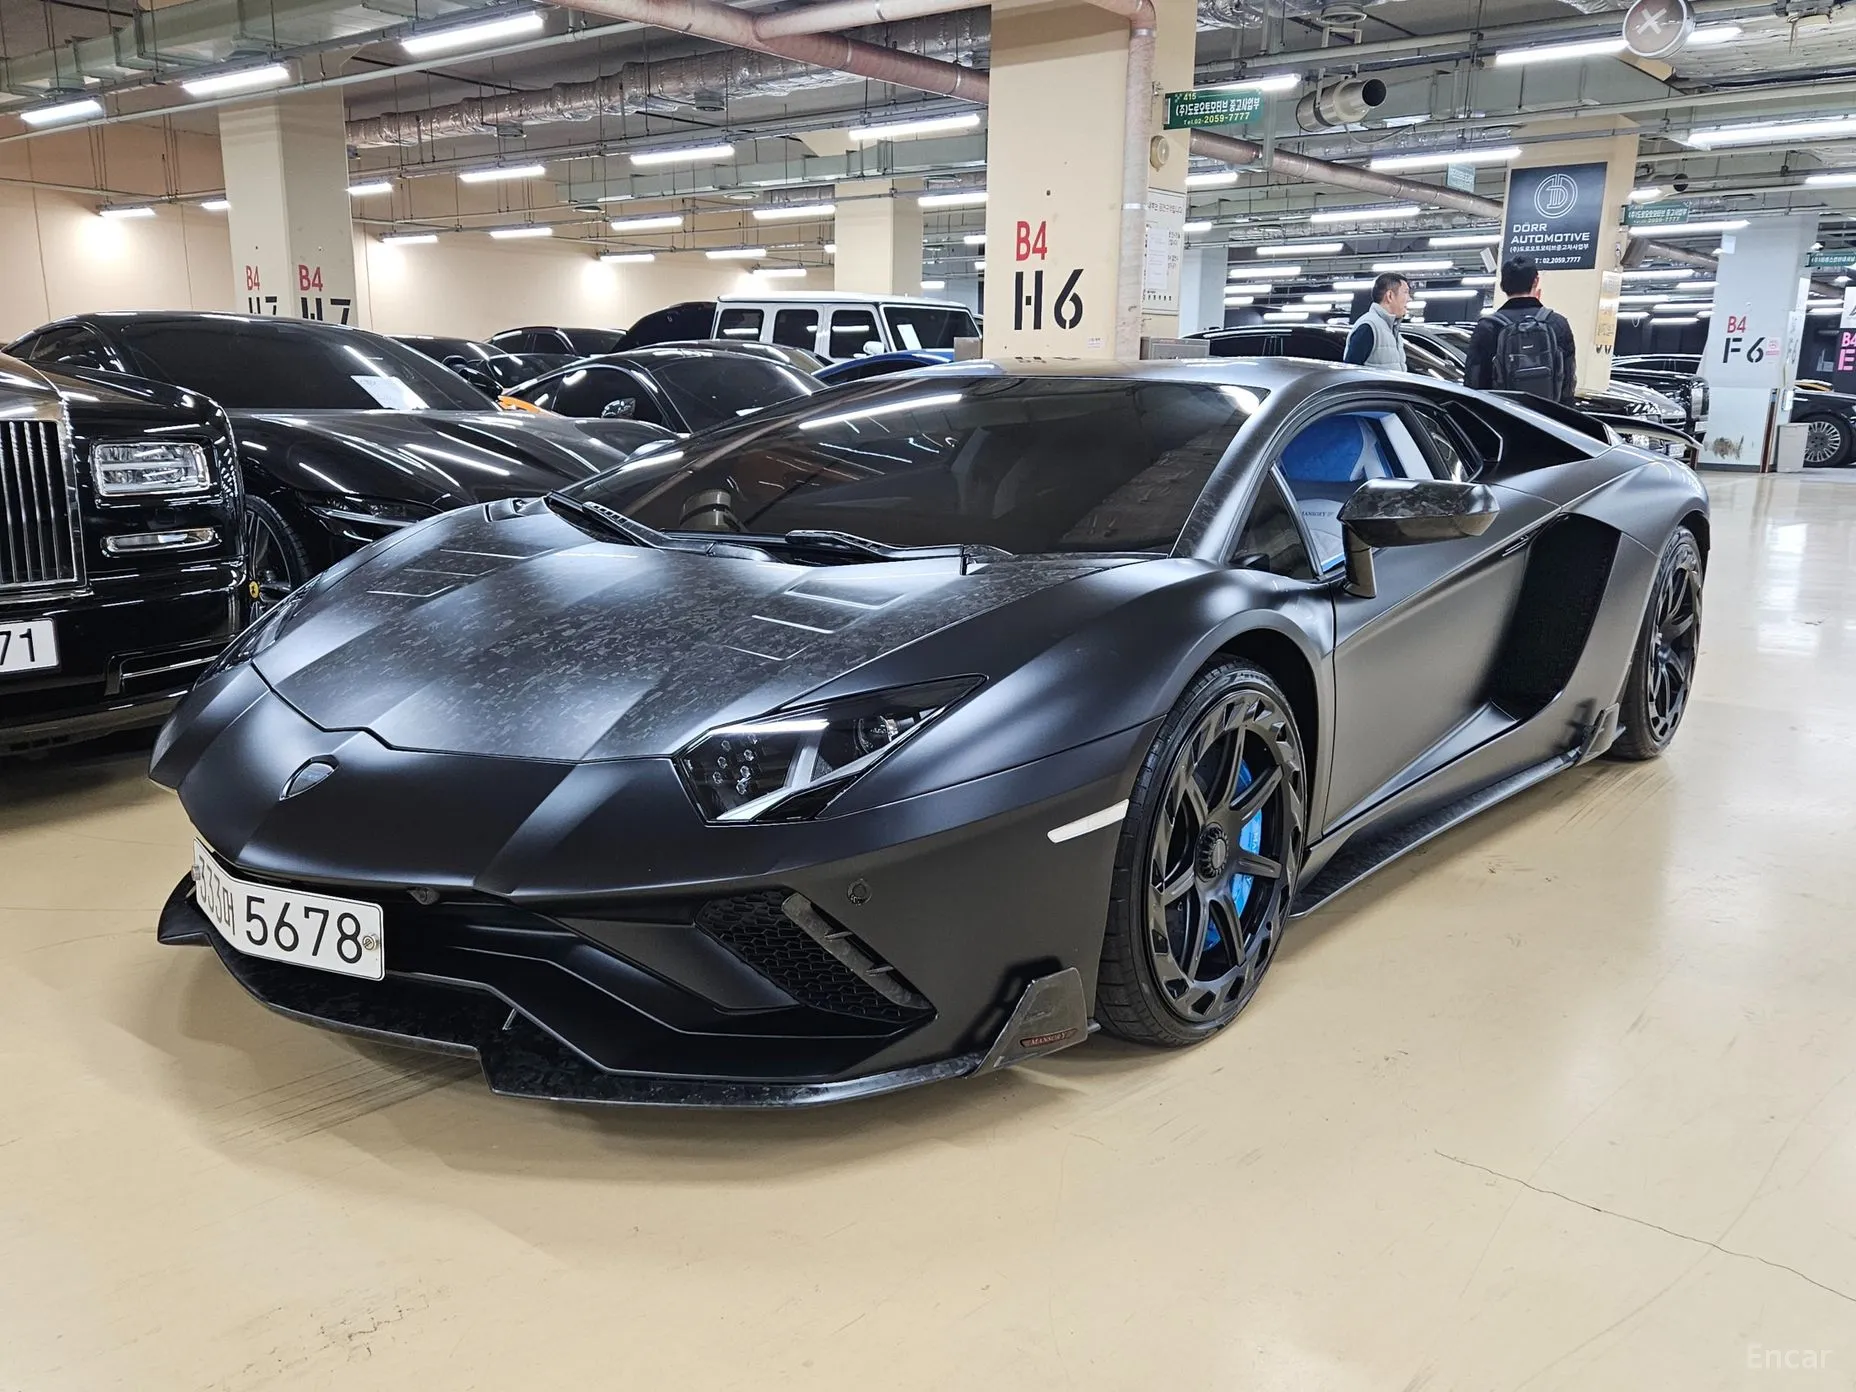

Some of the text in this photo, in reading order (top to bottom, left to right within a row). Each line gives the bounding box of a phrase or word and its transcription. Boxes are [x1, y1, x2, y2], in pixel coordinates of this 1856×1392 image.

[1183, 93, 1197, 101] 415
[1016, 220, 1048, 261] B4
[1510, 232, 1591, 244] AUTOMOTIVE
[246, 265, 260, 291] B4
[298, 264, 324, 292] B4
[1727, 315, 1747, 333] B4
[0, 628, 36, 666] 71
[246, 894, 363, 964] 5678
